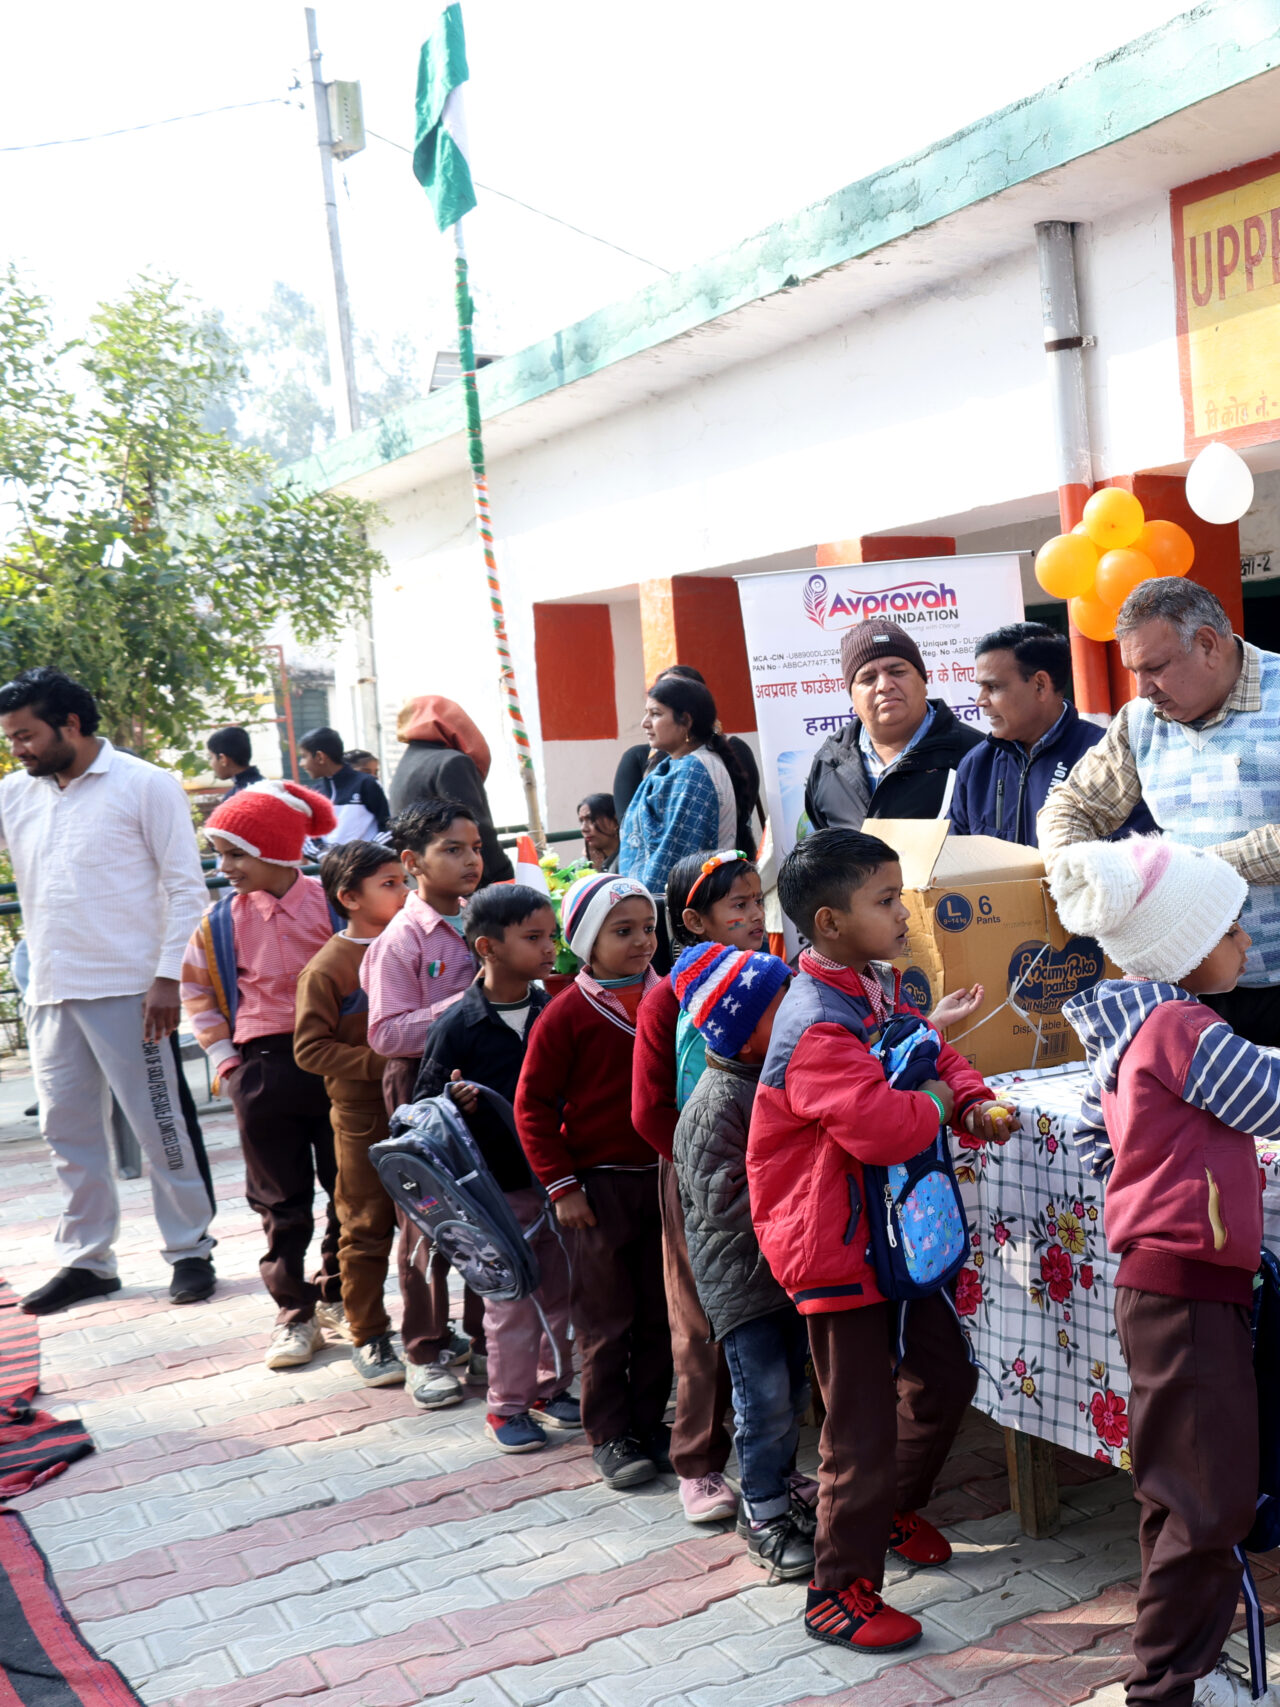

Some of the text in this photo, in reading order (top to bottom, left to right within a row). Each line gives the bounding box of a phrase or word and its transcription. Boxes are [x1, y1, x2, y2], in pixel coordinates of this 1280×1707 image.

[828, 583, 957, 620] Avpravah
[923, 639, 948, 649] Unique
[940, 648, 950, 656] No
[937, 662, 949, 684] के
[952, 662, 976, 683] लिए
[756, 681, 797, 699] अवप्रवाह
[946, 895, 993, 917] L 6
[976, 915, 1000, 925] Pants
[1043, 978, 1078, 998] pants
[1021, 999, 1058, 1011] All Night
[1013, 1020, 1061, 1036] Dispable
[165, 1145, 184, 1171] EDITION
